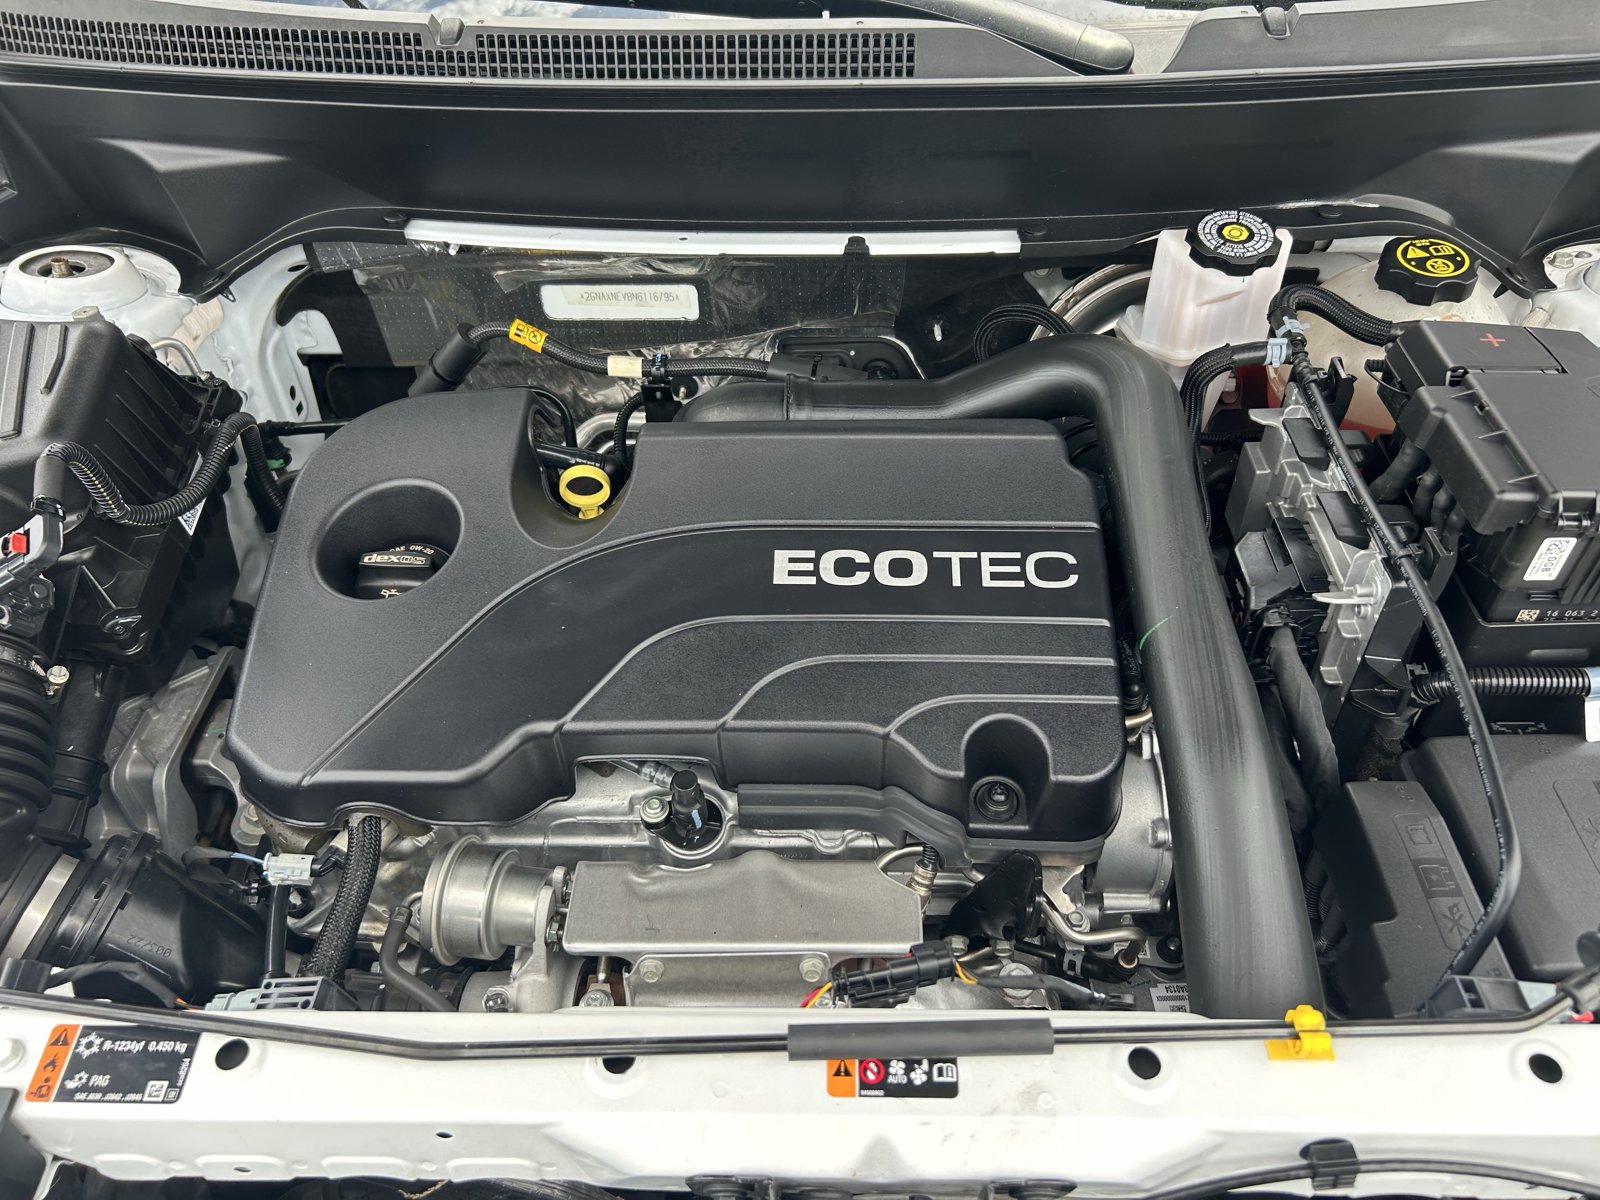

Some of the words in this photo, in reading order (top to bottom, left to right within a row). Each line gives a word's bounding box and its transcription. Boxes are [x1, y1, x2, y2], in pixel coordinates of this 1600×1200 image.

[409, 544, 434, 555] 0W-20
[363, 553, 427, 565] dexos
[772, 549, 1080, 588] ECOTEC
[1546, 609, 1559, 617] 16
[1564, 609, 1586, 617] 063
[126, 934, 173, 958] 003/22
[102, 1039, 146, 1054] R-1234yf
[147, 1040, 175, 1053] 0.450
[174, 1040, 188, 1055] kg
[88, 1074, 111, 1087] PAG
[886, 1074, 908, 1085] AUTO
